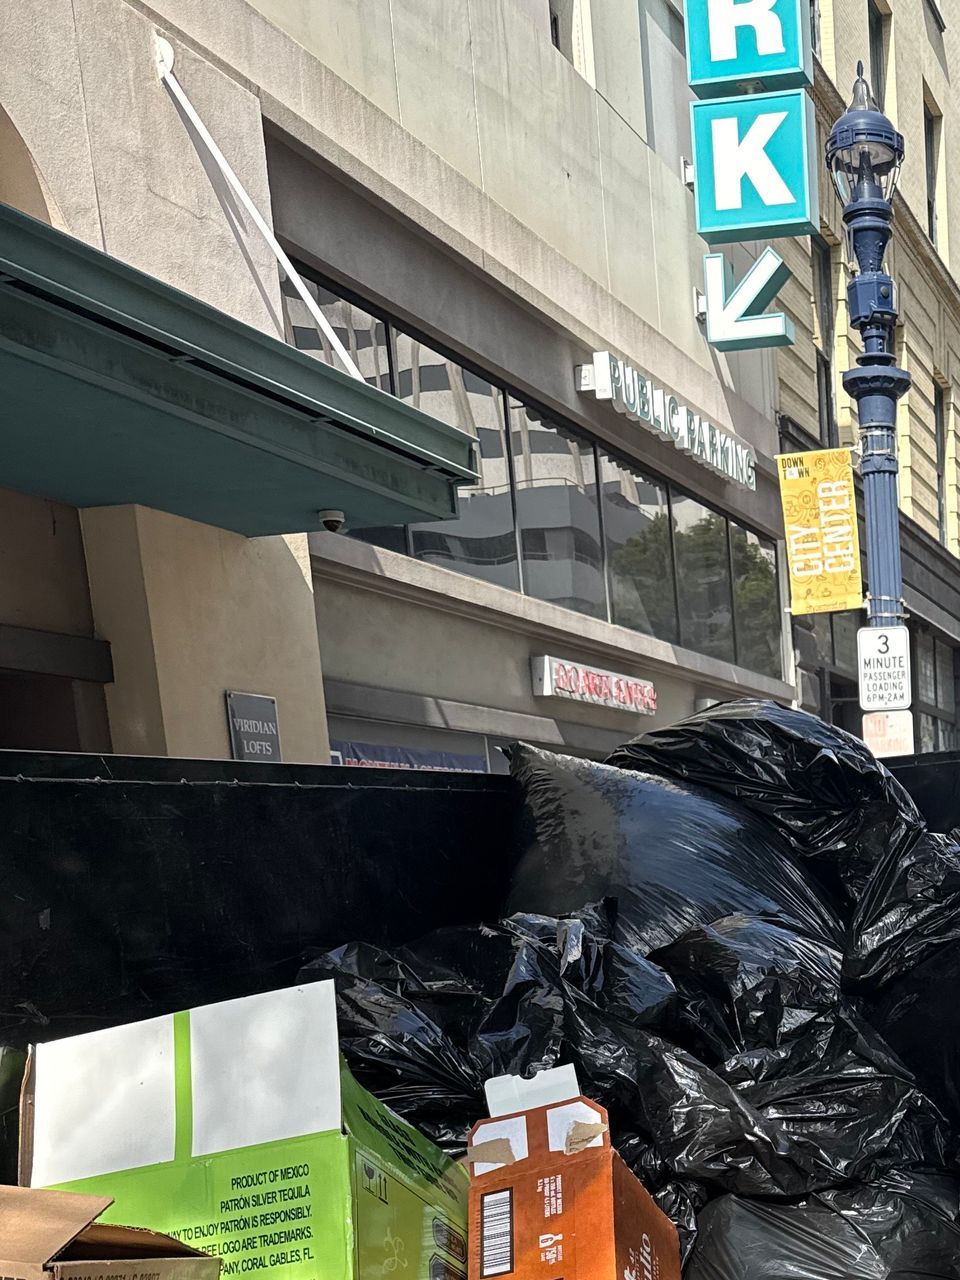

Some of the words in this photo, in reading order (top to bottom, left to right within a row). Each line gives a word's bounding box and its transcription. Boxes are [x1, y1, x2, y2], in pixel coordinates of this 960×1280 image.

[600, 352, 680, 442] PUBLIC
[683, 406, 757, 491] PARKING
[781, 457, 804, 469] DOWN
[817, 480, 855, 573] CENTER
[789, 524, 824, 577] CITY
[877, 634, 889, 654] 3
[863, 656, 905, 670] MINUTE
[863, 671, 906, 681] PASSENGER
[866, 682, 904, 692] LOADING
[233, 718, 277, 735] VIRIDIAN
[243, 740, 273, 755] LOFTS
[231, 1172, 267, 1190] PRODUCT
[269, 1169, 279, 1183] OF
[281, 1164, 309, 1181] MEXICO
[220, 1195, 250, 1213] PATRÓN
[252, 1191, 277, 1208] SILVER
[278, 1185, 311, 1200] TEQUILA
[183, 1228, 193, 1241] TO
[194, 1223, 220, 1239] ENJOY
[220, 1216, 250, 1234] PATRÓN
[251, 1216, 259, 1228] IS
[260, 1205, 312, 1226] RESPONSIBLY.
[218, 1241, 241, 1256] LOGO
[241, 1238, 258, 1252] ARE
[259, 1226, 313, 1248] TRADEMARKS.
[241, 1255, 268, 1272] CORAL
